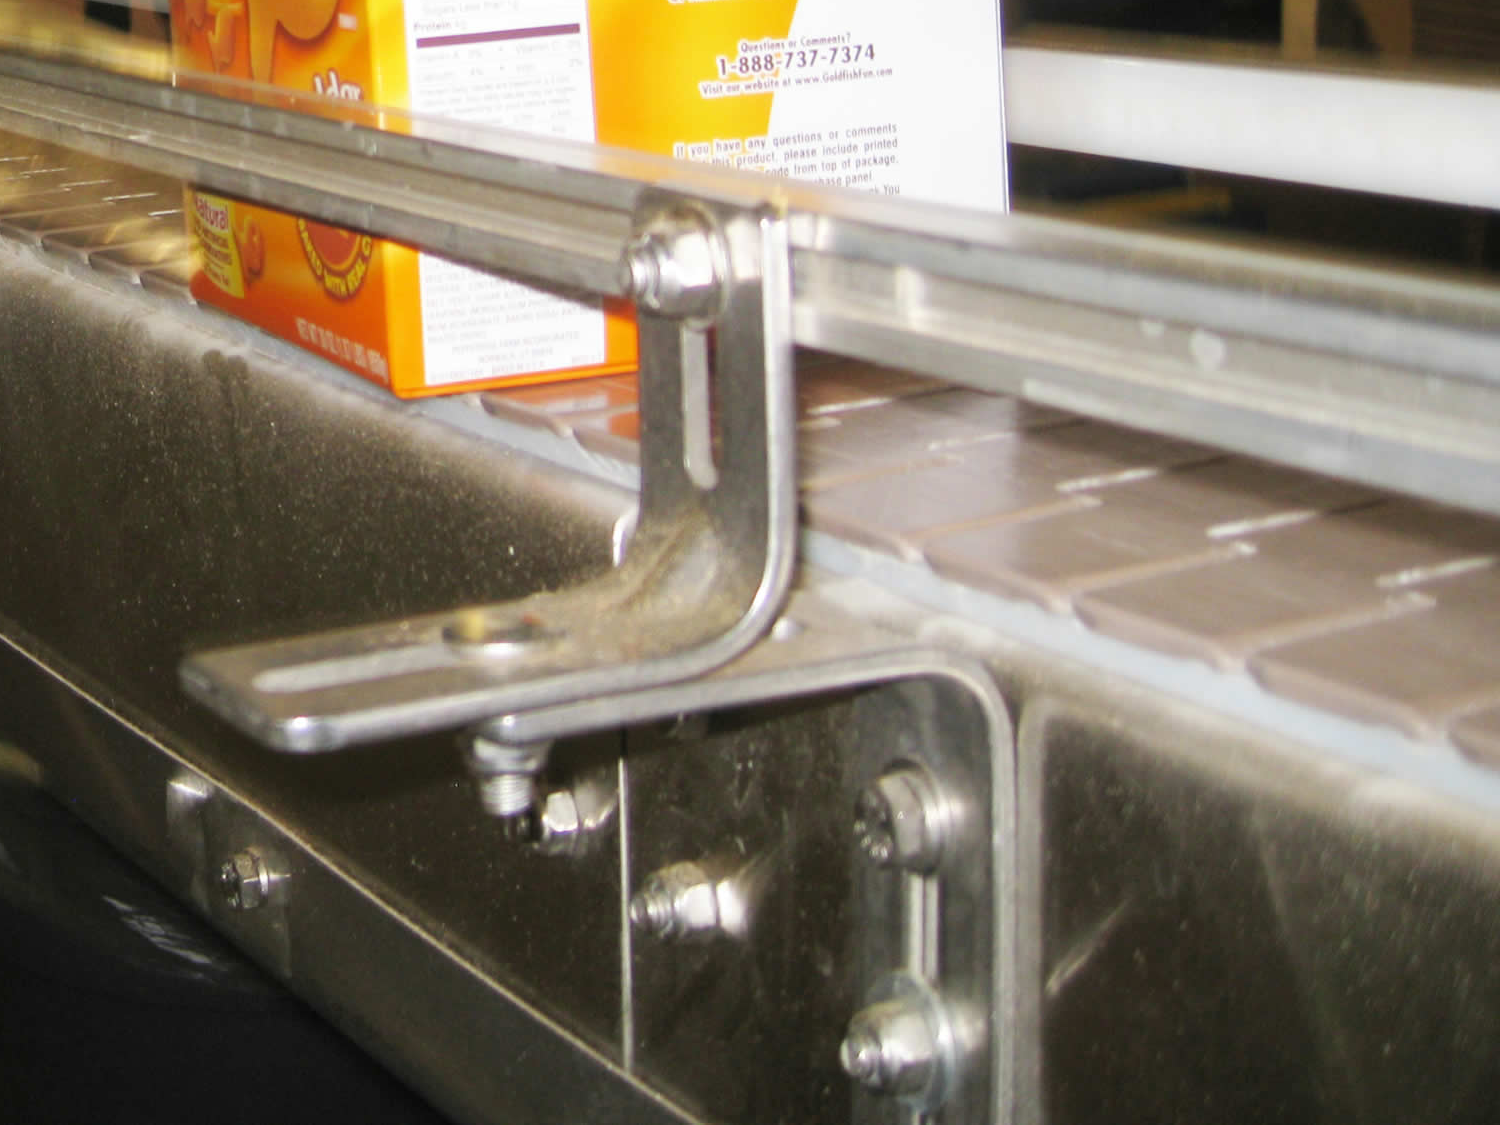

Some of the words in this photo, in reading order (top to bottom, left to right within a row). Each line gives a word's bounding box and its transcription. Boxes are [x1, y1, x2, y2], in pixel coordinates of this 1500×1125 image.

[413, 20, 452, 34] Protein
[741, 40, 785, 54] Questions
[788, 39, 797, 49] or
[800, 31, 852, 47] Comments?
[720, 43, 875, 76] 1-888-737-7374
[702, 82, 723, 95] Visit
[726, 83, 741, 93] our
[744, 77, 780, 91] website
[782, 77, 792, 87] at
[794, 67, 893, 85] www.GoldfishFun.com
[690, 146, 709, 157] you
[716, 138, 742, 152] have
[748, 137, 766, 150] any
[773, 129, 822, 147] questions
[829, 129, 840, 140] or
[846, 122, 897, 138] comments
[784, 148, 818, 163] please
[822, 142, 859, 159] include
[864, 138, 898, 154] printed
[793, 163, 818, 175] from
[821, 160, 837, 172] top
[841, 158, 851, 169] of
[855, 153, 900, 170] package.
